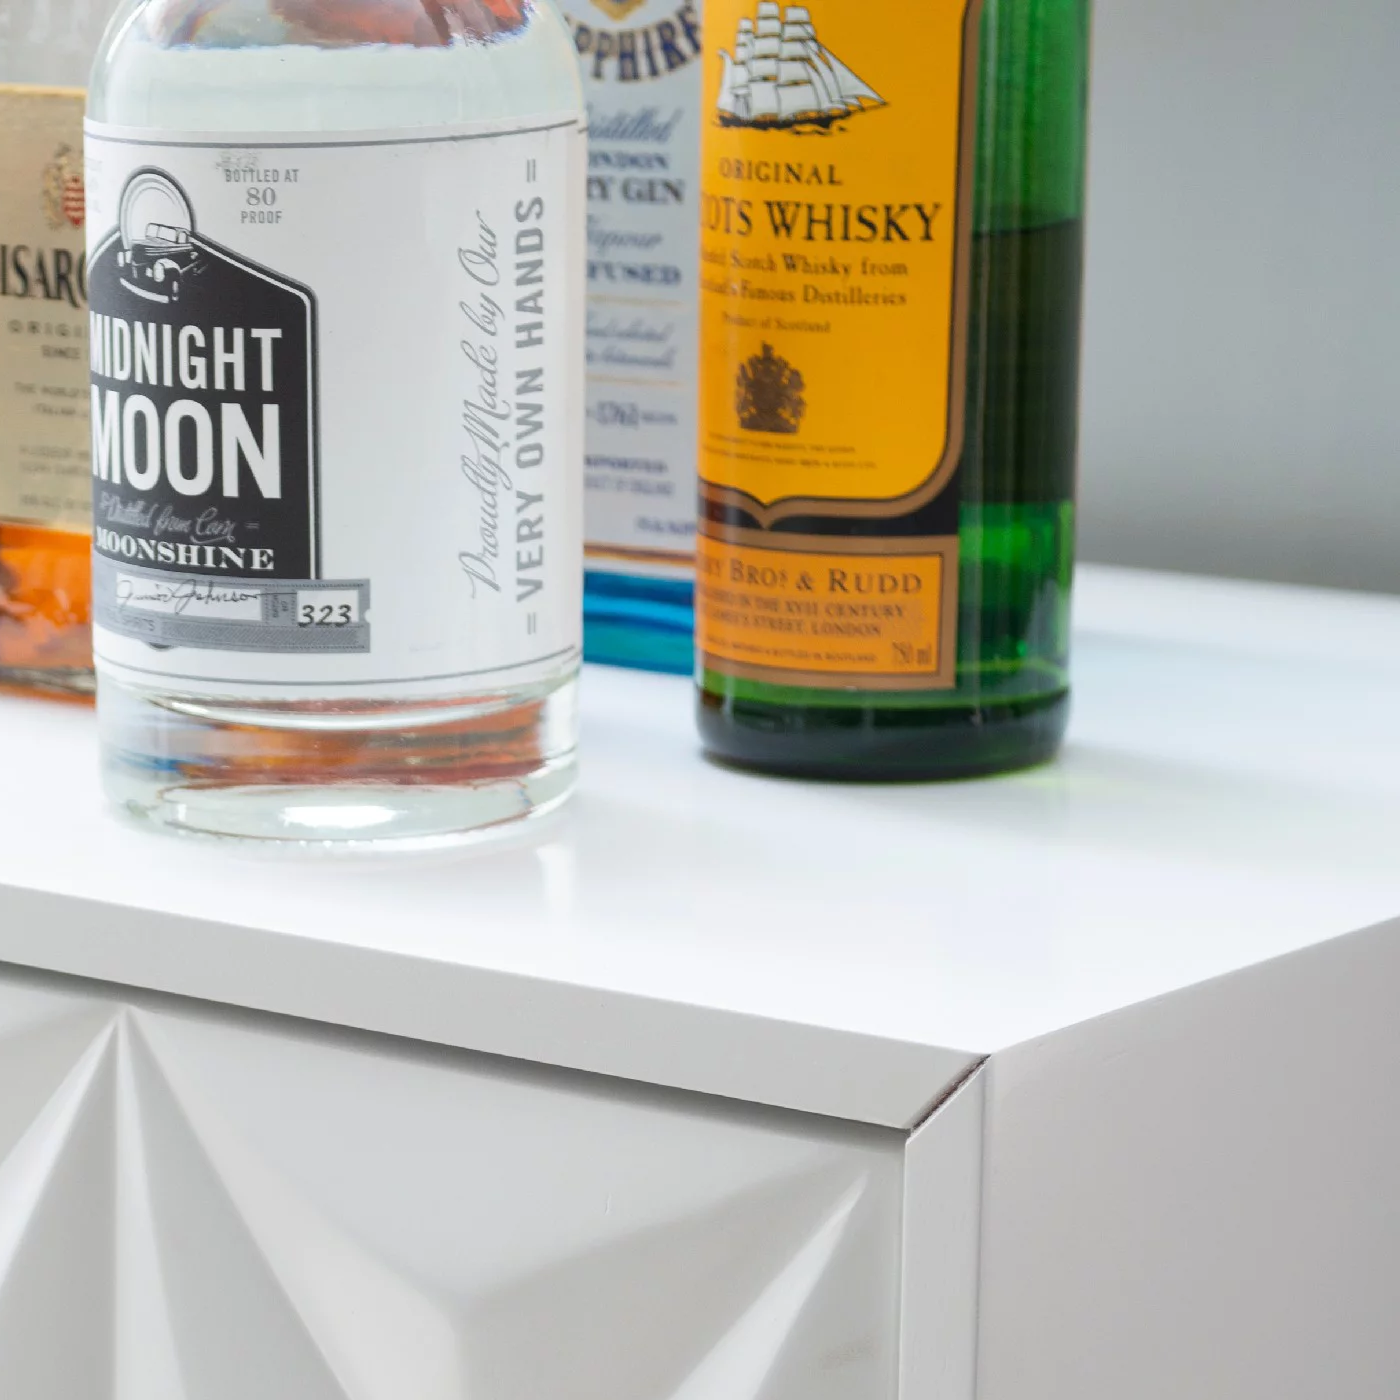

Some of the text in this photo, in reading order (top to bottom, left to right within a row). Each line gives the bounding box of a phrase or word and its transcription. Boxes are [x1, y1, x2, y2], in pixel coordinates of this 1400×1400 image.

[563, 0, 701, 82] PPHIRE
[223, 168, 300, 183] BOTTLED AT
[717, 157, 844, 187] ORIGINAL
[246, 186, 277, 207] 80
[240, 210, 283, 225] PROOF
[700, 192, 942, 244] OTS WHISKY
[782, 252, 852, 277] Whisky
[860, 256, 909, 277] from
[803, 283, 908, 307] Distilleries
[457, 208, 513, 600] Proudly Made by Our
[514, 196, 545, 603] VERY OWN HANDS
[90, 383, 282, 499] MOON
[95, 524, 275, 571] MOONSHINE
[827, 566, 923, 595] RUDD
[296, 603, 352, 628] 323
